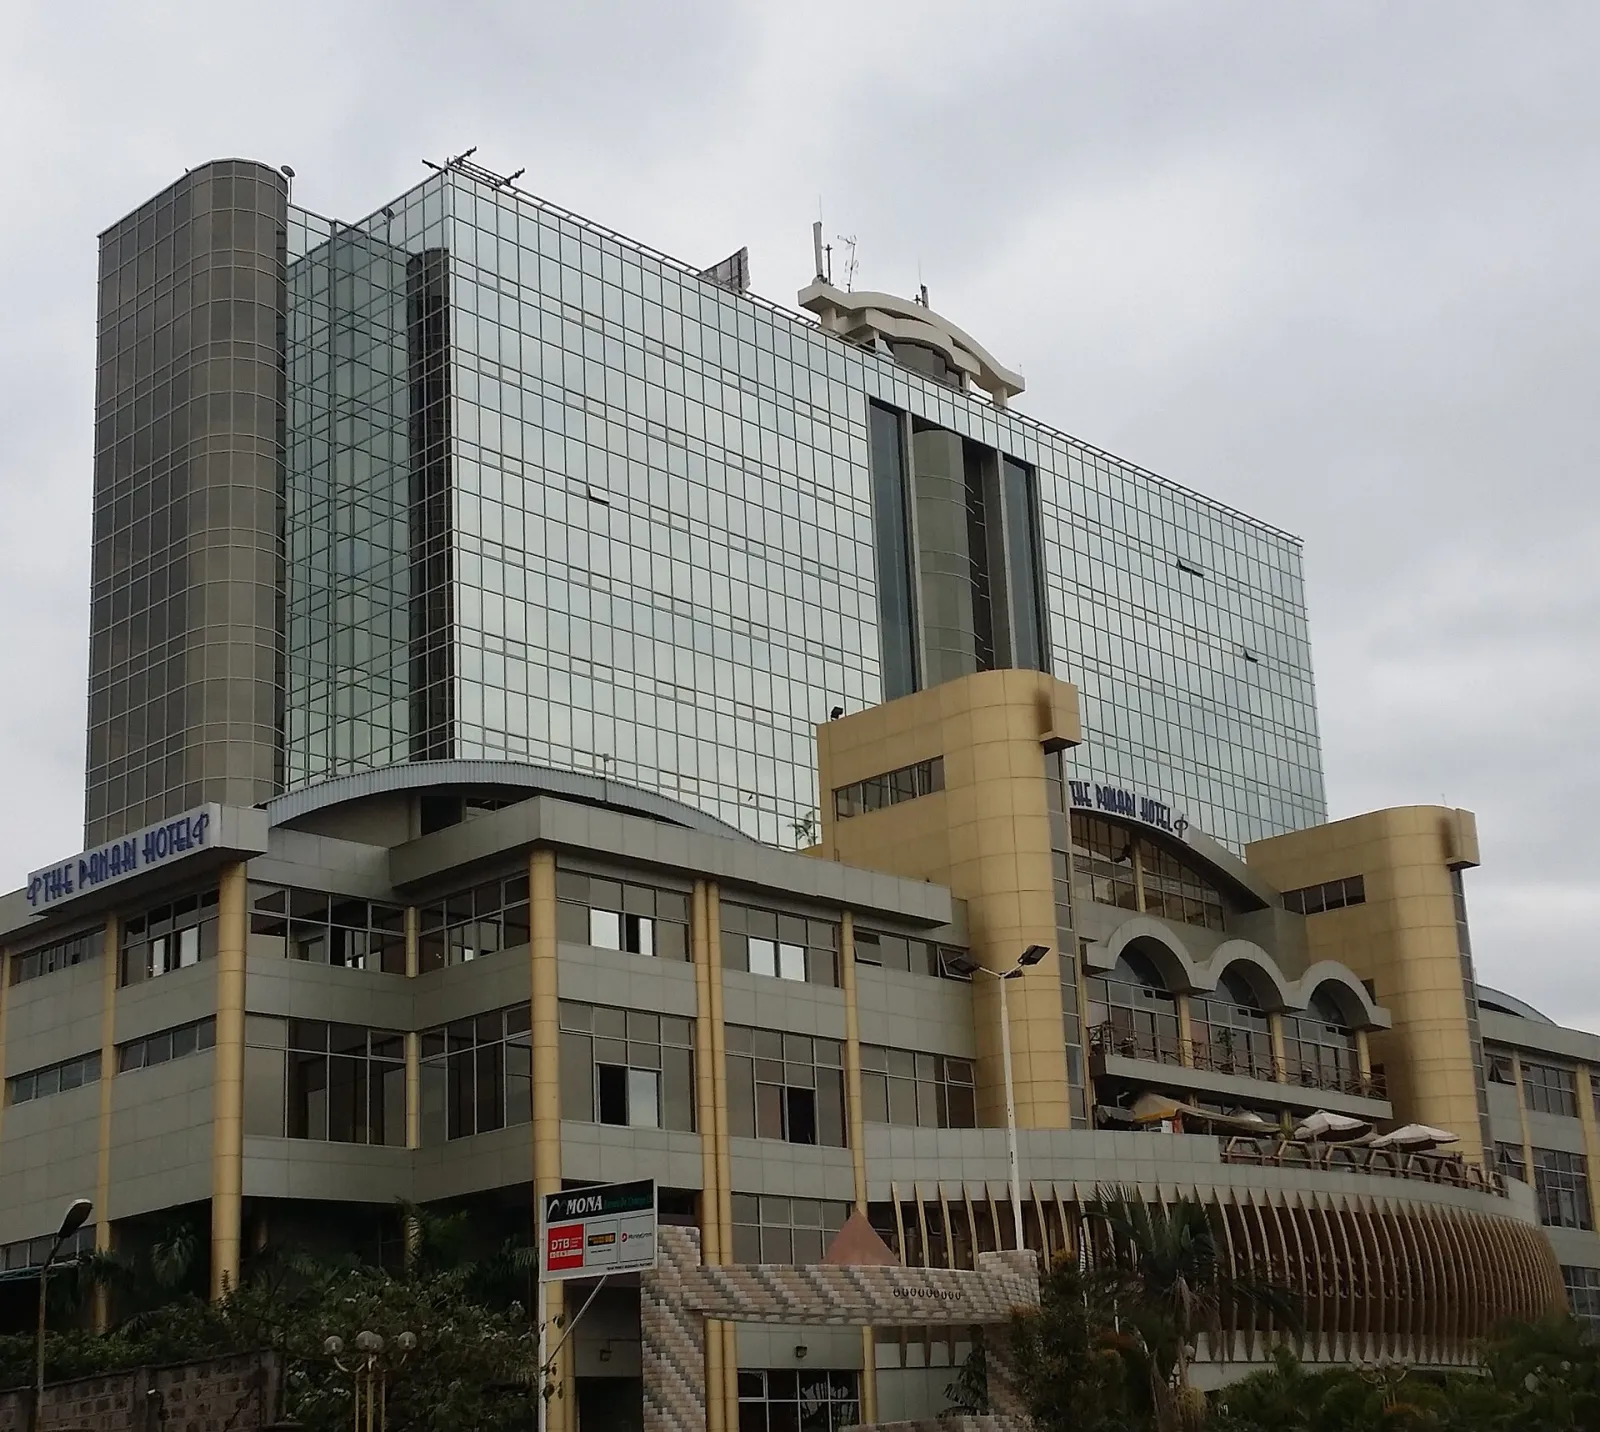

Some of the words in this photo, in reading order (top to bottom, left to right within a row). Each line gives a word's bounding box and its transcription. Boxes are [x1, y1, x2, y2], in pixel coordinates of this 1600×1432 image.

[1069, 780, 1092, 807] THE
[1095, 783, 1137, 818] PANARI
[1140, 796, 1173, 832] HOTEL
[42, 862, 74, 902] THE
[78, 837, 138, 889] PANARI
[142, 816, 194, 864] HOTEL
[566, 1195, 603, 1215] MONA
[551, 1238, 570, 1251] DTB
